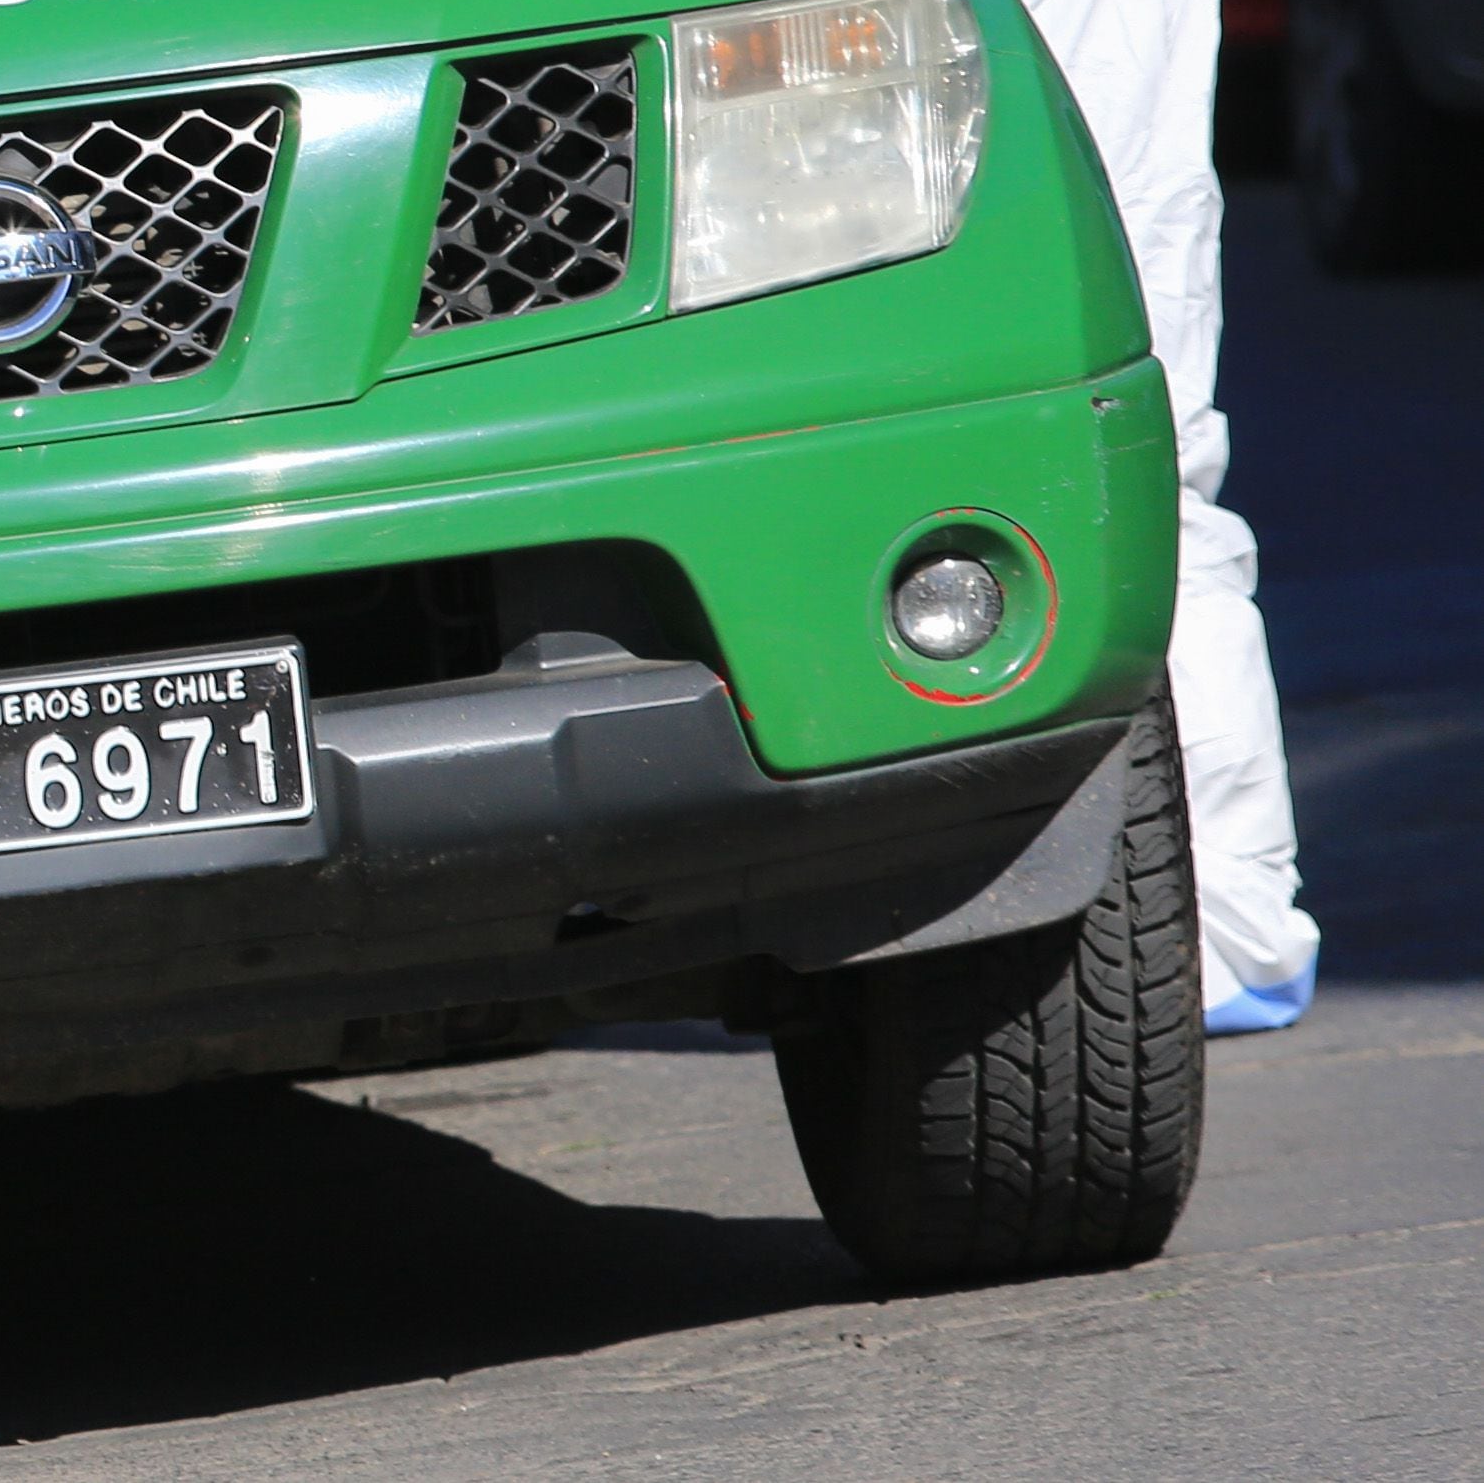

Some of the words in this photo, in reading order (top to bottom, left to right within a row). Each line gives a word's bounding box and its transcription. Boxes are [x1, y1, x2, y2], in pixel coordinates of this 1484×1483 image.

[101, 680, 143, 715] DE
[153, 669, 248, 704] CHILE
[24, 708, 279, 829] 6971
